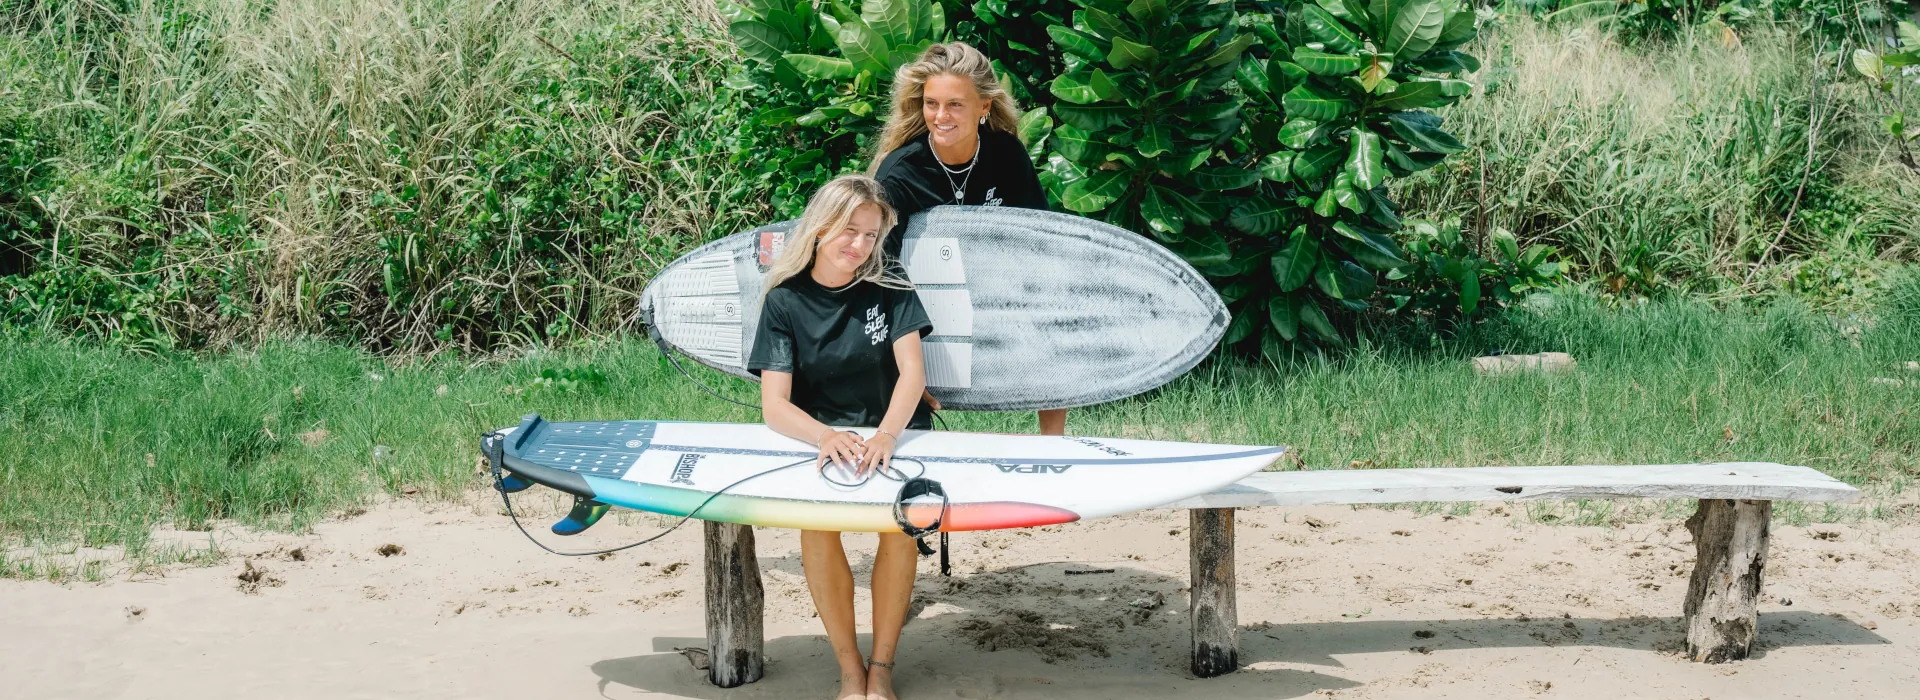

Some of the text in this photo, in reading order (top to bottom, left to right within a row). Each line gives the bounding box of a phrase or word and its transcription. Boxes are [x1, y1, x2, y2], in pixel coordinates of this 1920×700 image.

[866, 303, 879, 321] EAT
[676, 453, 701, 479] BISHOP
[994, 463, 1073, 474] AIPA
